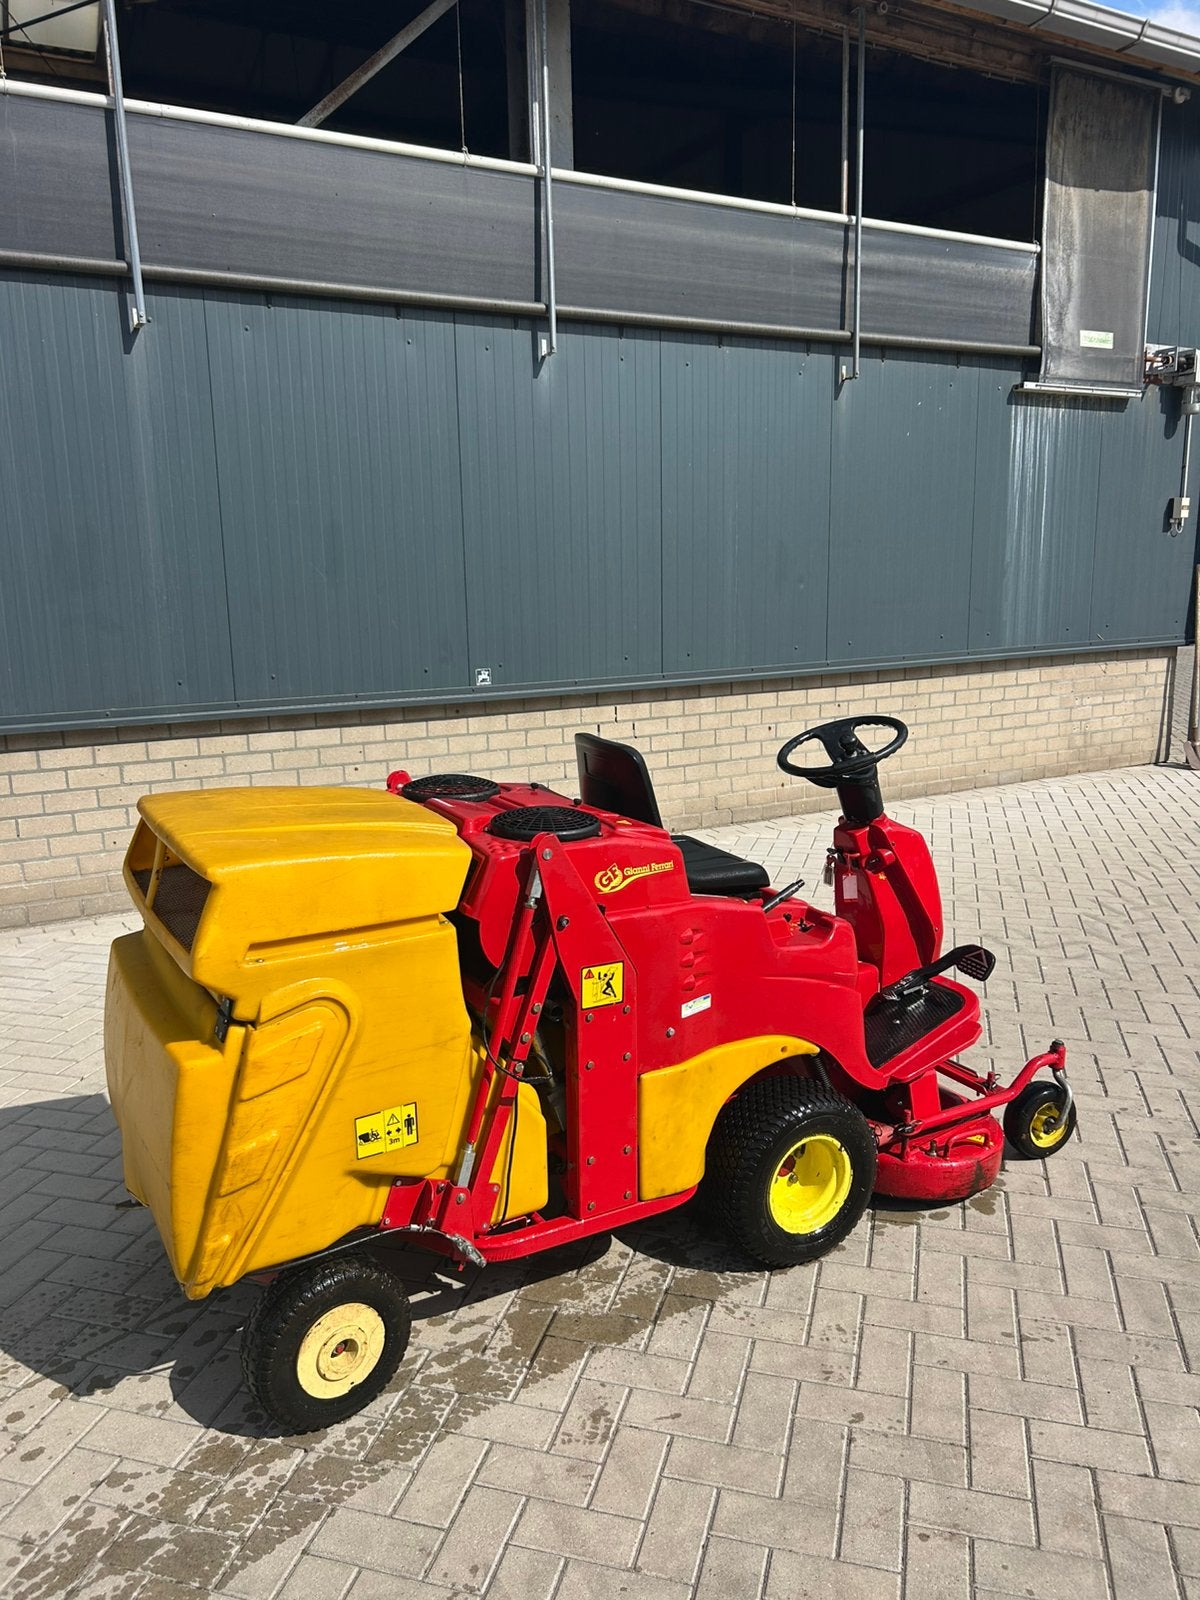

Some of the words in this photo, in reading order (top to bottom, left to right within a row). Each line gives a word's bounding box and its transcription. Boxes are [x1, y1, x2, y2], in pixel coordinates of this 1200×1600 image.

[624, 864, 650, 876] Gianni
[651, 860, 674, 872] Ferrari
[389, 1137, 400, 1145] 3m
